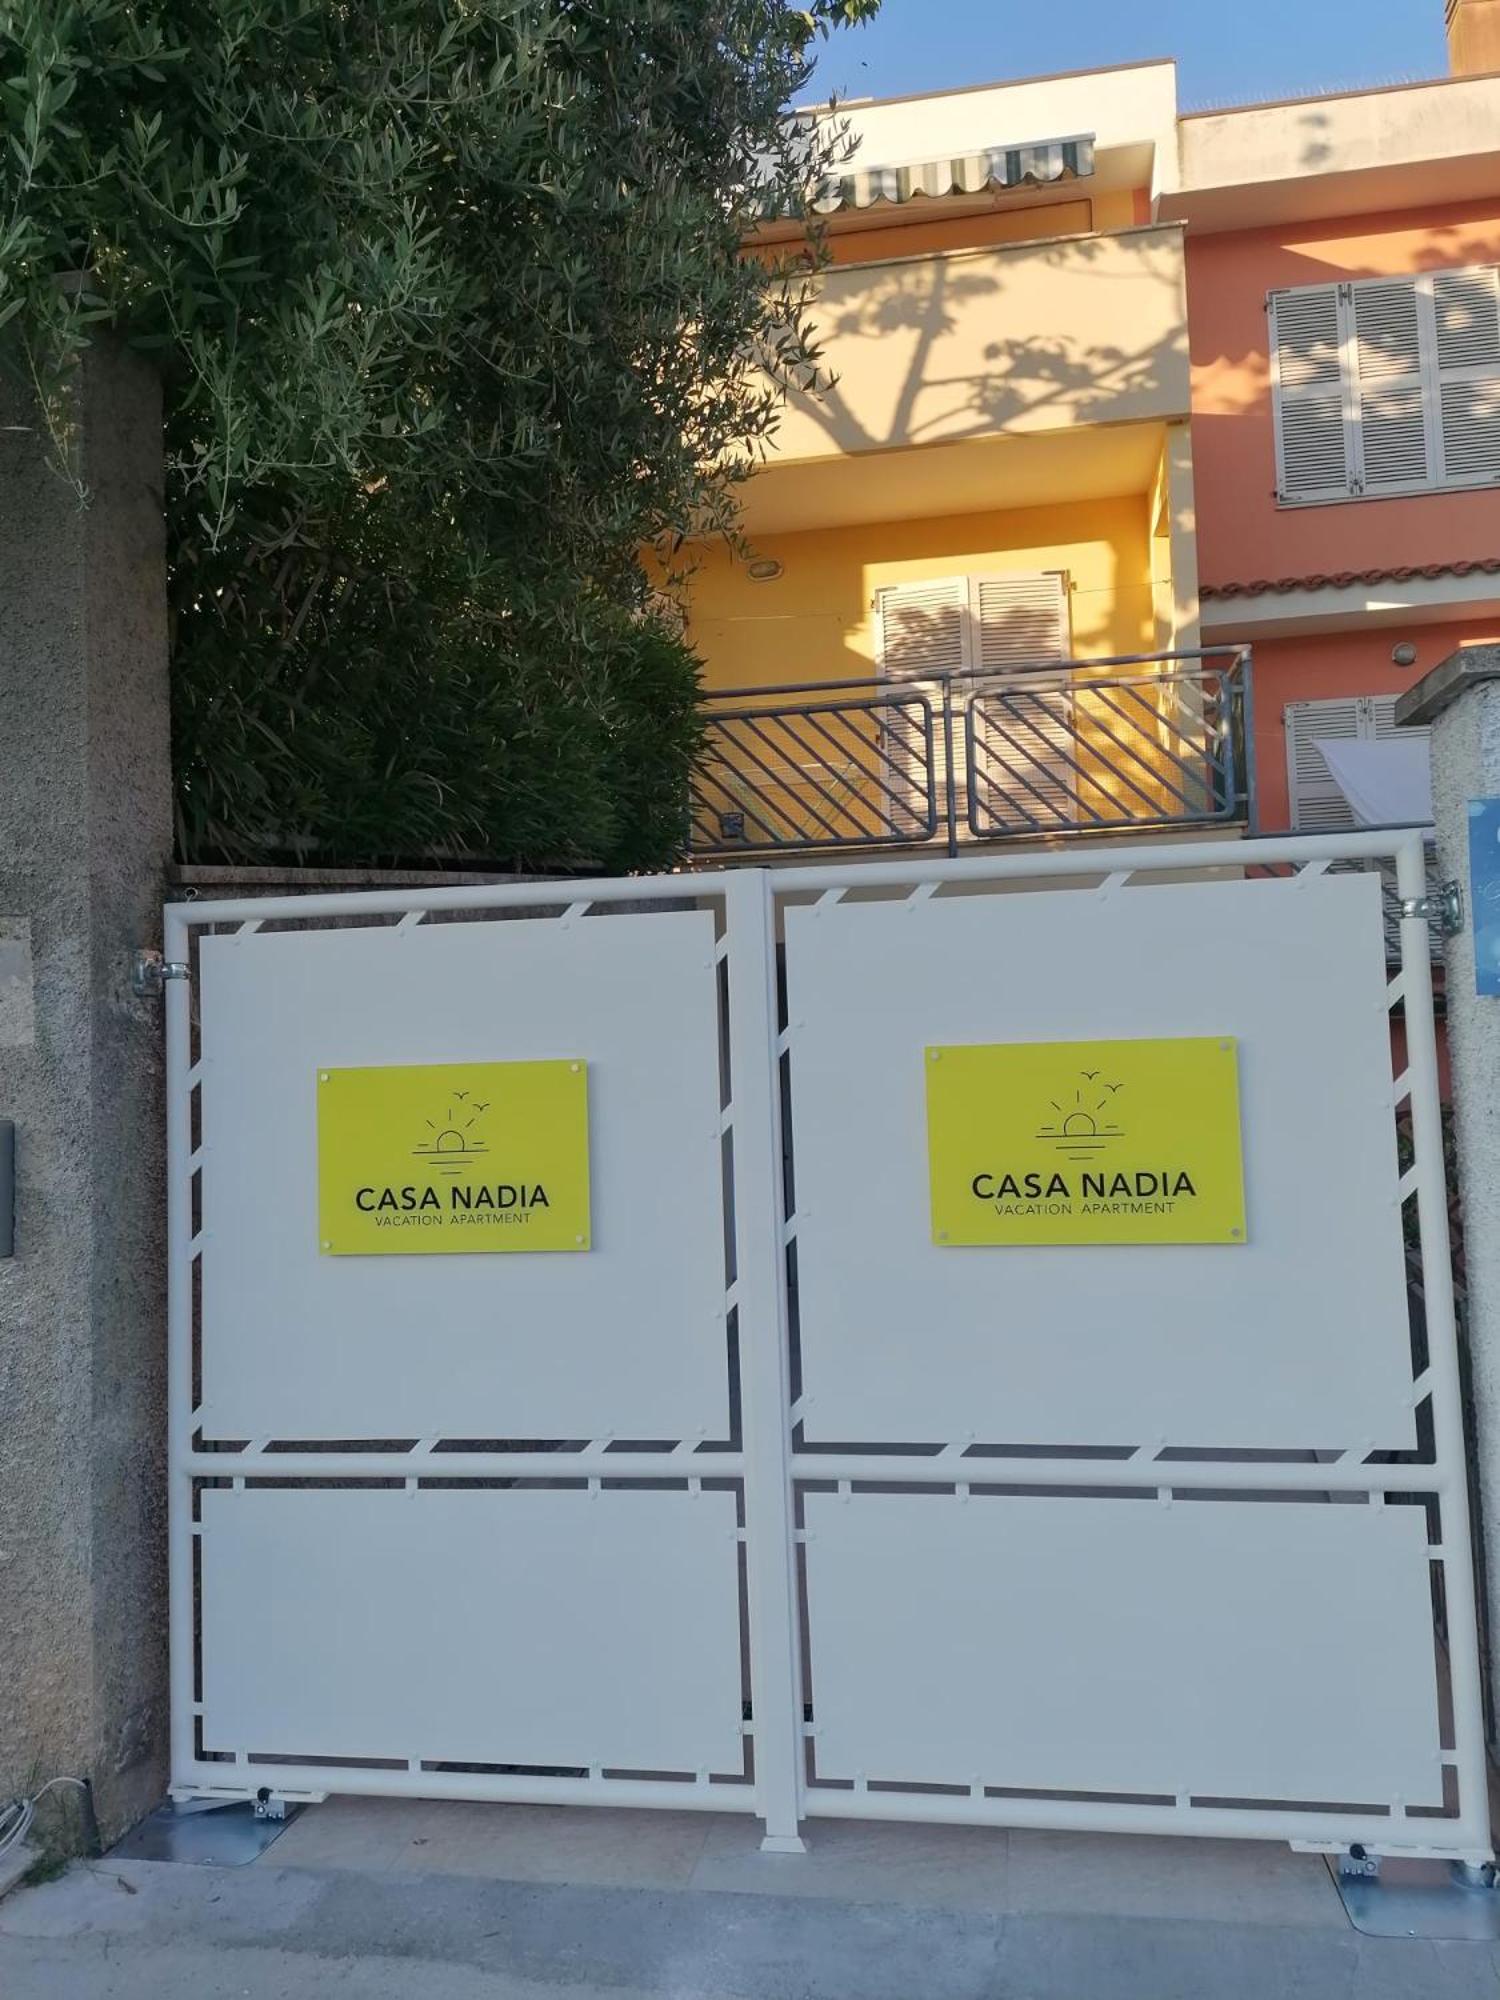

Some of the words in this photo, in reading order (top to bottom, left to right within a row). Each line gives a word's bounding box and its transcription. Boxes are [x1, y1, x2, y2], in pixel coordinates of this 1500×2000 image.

[971, 1172, 1071, 1199] CASA
[1081, 1171, 1197, 1198] NADIA
[355, 1186, 441, 1212] CASA
[451, 1184, 550, 1209] NADIA
[994, 1202, 1073, 1216] VACATION
[1080, 1201, 1176, 1215] APARTMENT
[375, 1214, 443, 1226] VACATION
[450, 1213, 531, 1225] APARTMENT
